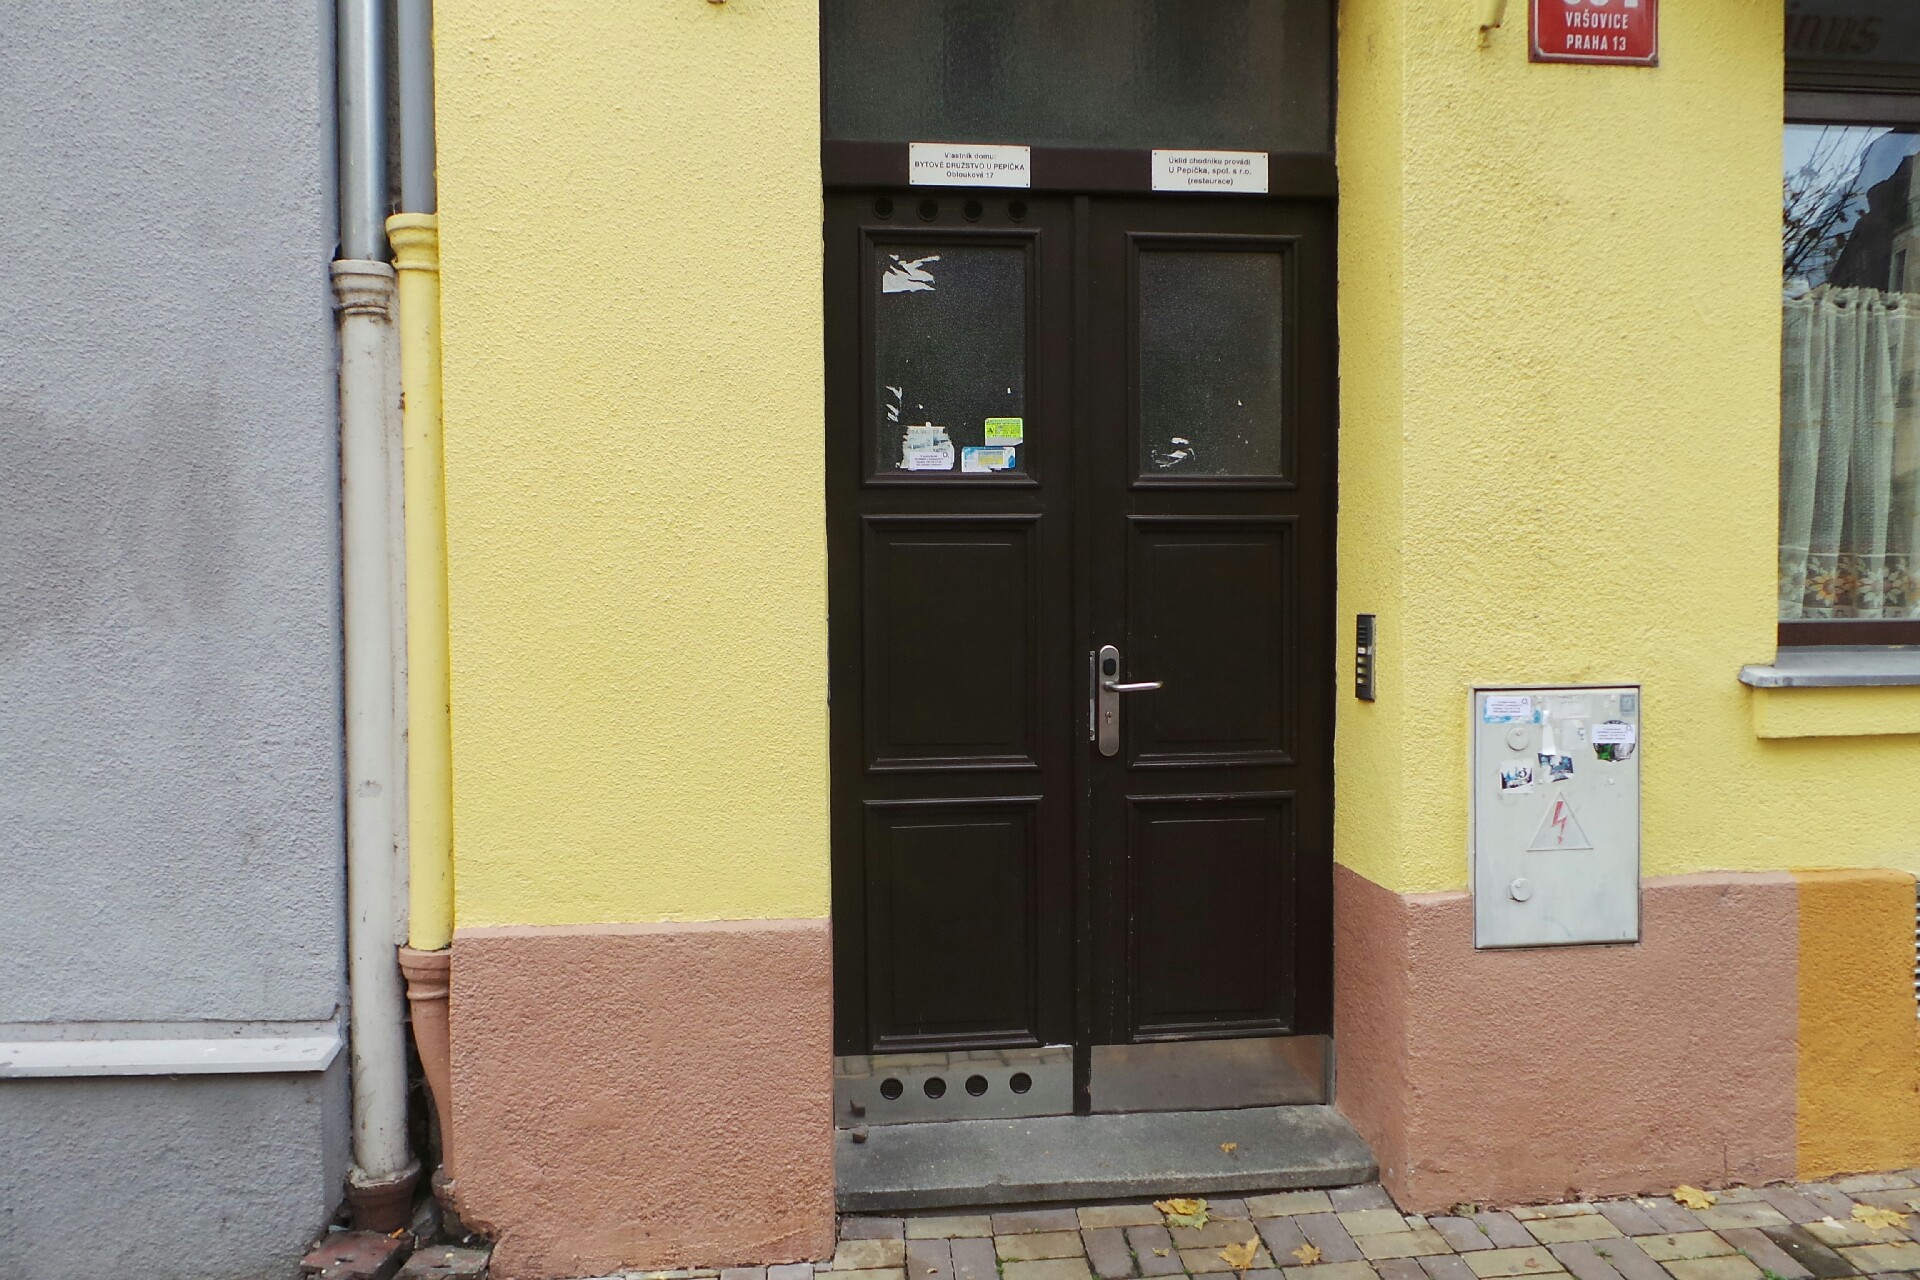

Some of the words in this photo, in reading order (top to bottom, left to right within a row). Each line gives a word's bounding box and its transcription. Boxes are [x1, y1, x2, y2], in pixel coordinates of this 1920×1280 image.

[1565, 9, 1629, 29] VRŠOVICE
[1566, 34, 1608, 50] PRAHA
[1613, 36, 1627, 51] 13
[1168, 156, 1188, 164] Úklid
[914, 161, 944, 169] BYTOVÉ
[945, 162, 985, 170] DRUŽSTVO
[993, 162, 1025, 171] PEPÍČKA
[1176, 166, 1210, 176] Pepíčka,
[1212, 168, 1231, 176] spol.
[1187, 177, 1234, 186] (restaurace)
